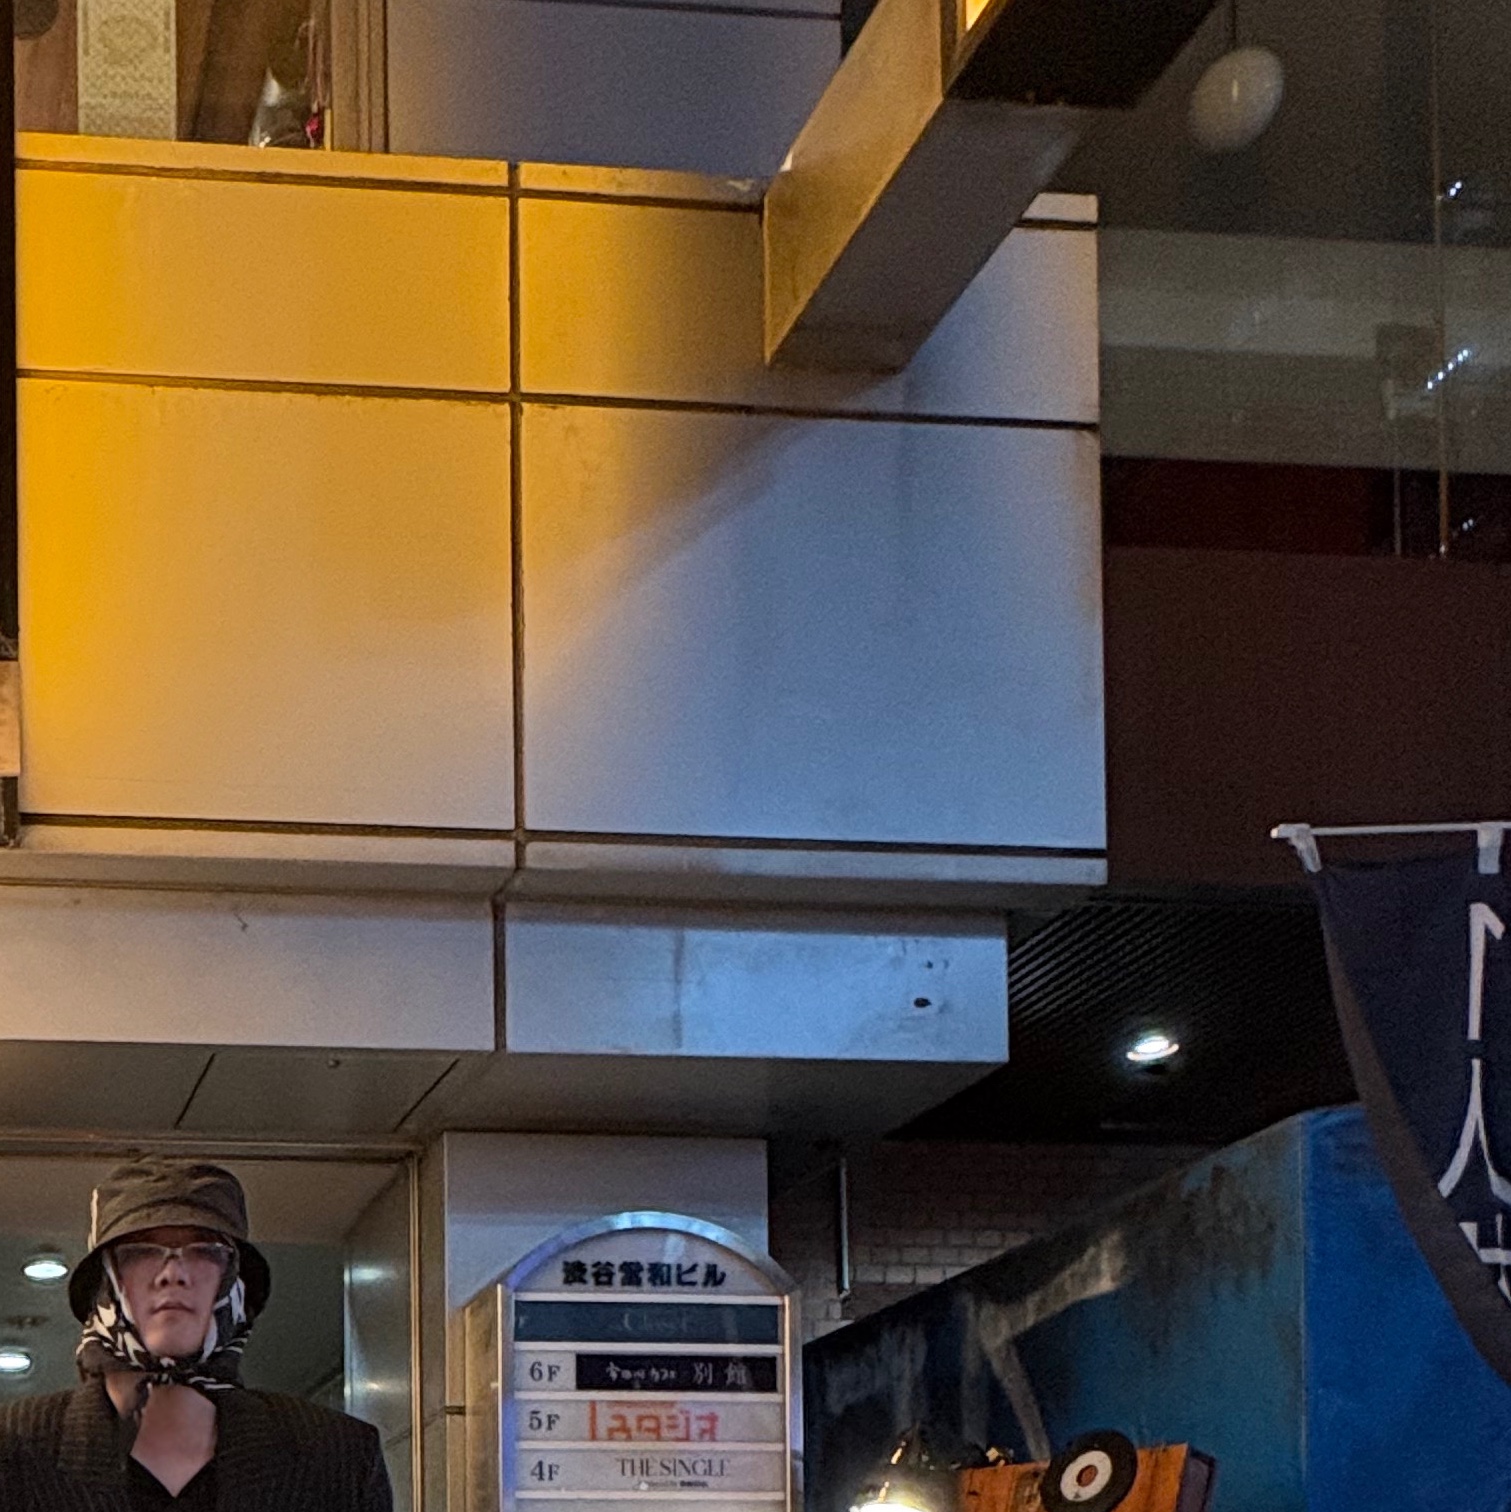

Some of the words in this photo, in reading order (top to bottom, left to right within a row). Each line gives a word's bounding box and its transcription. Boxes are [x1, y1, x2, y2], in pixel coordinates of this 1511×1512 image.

[529, 1360, 562, 1384] 6F
[527, 1410, 561, 1432] 5F
[529, 1459, 561, 1482] 4F
